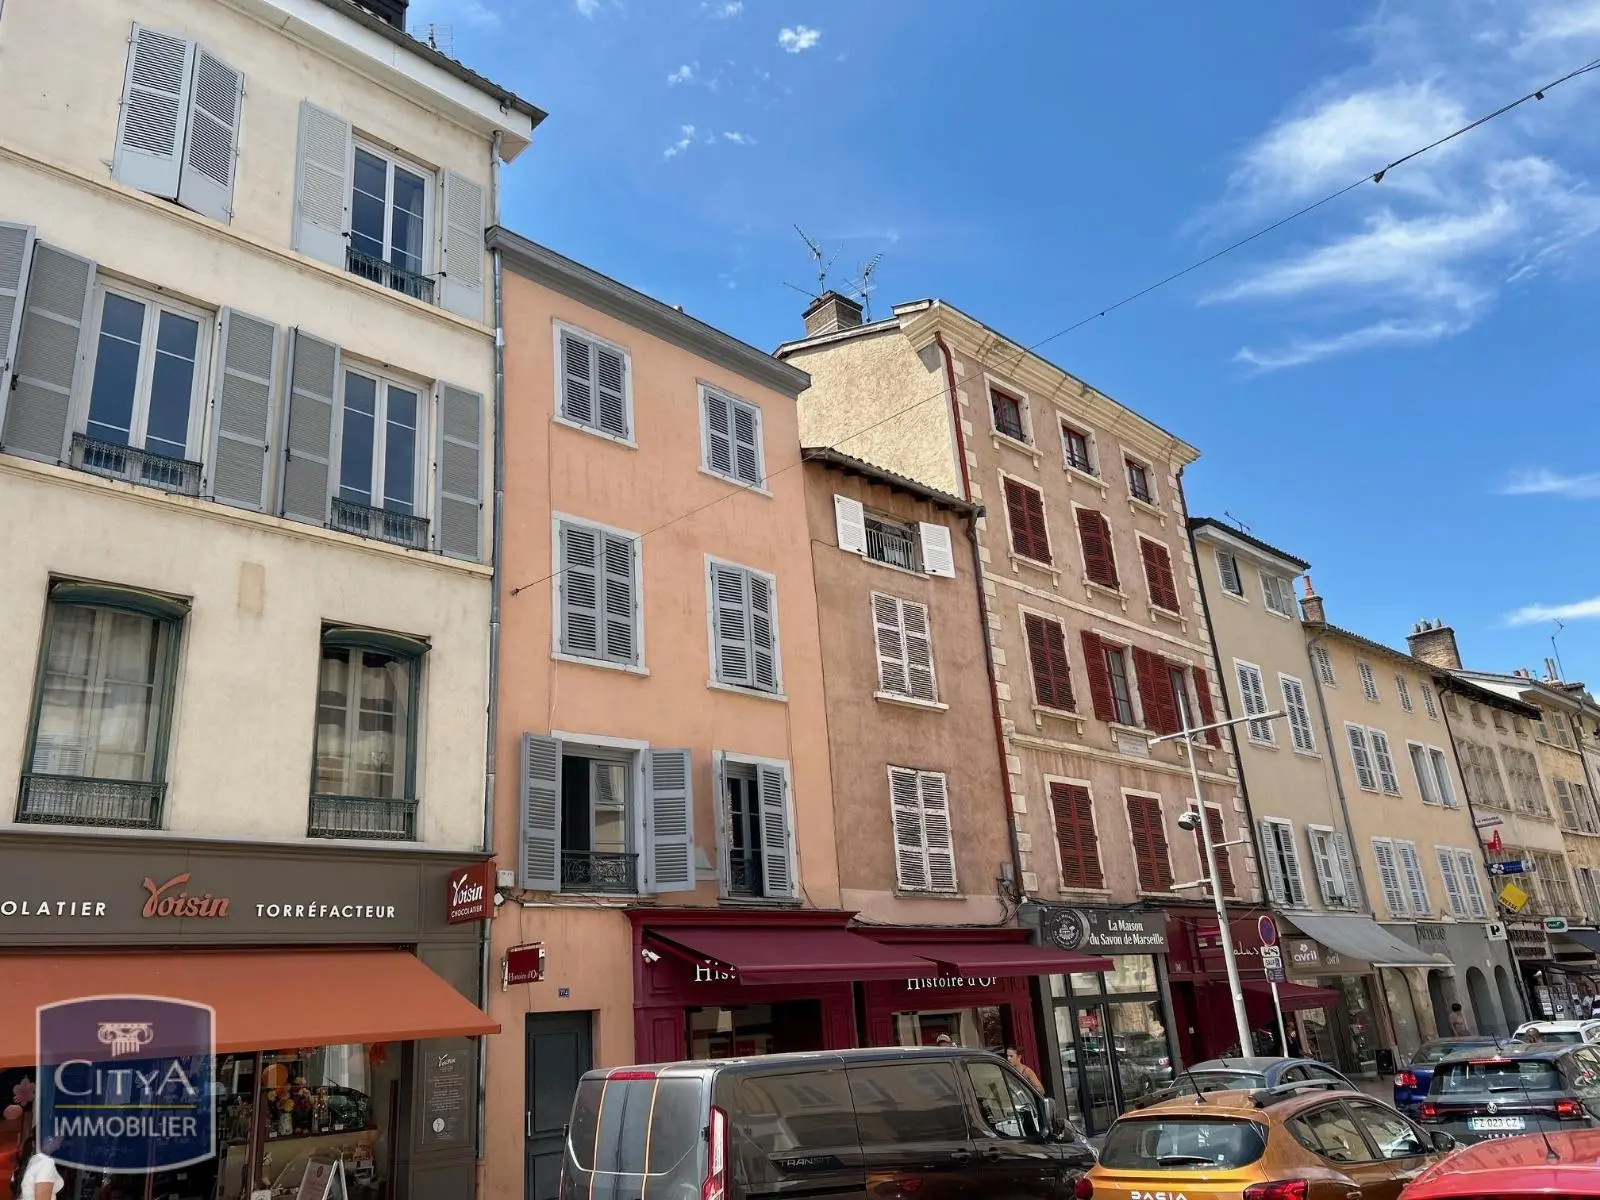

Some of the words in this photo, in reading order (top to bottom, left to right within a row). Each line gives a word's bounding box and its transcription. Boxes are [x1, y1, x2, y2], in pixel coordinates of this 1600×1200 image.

[142, 873, 230, 918] Voisin
[452, 873, 483, 907] Voisin
[0, 901, 107, 916] OLATIER
[256, 901, 395, 918] TORRÉFACTEUR
[451, 904, 483, 918] CHOCOLATIER
[1108, 920, 1118, 931] La
[1119, 920, 1144, 932] Maison
[1090, 933, 1100, 945] du
[1100, 933, 1123, 945] Savon
[1123, 933, 1132, 945] de
[1133, 933, 1164, 945] Marseille
[1294, 950, 1318, 962] avril
[694, 959, 736, 982] Hist
[1487, 1118, 1502, 1128] 023
